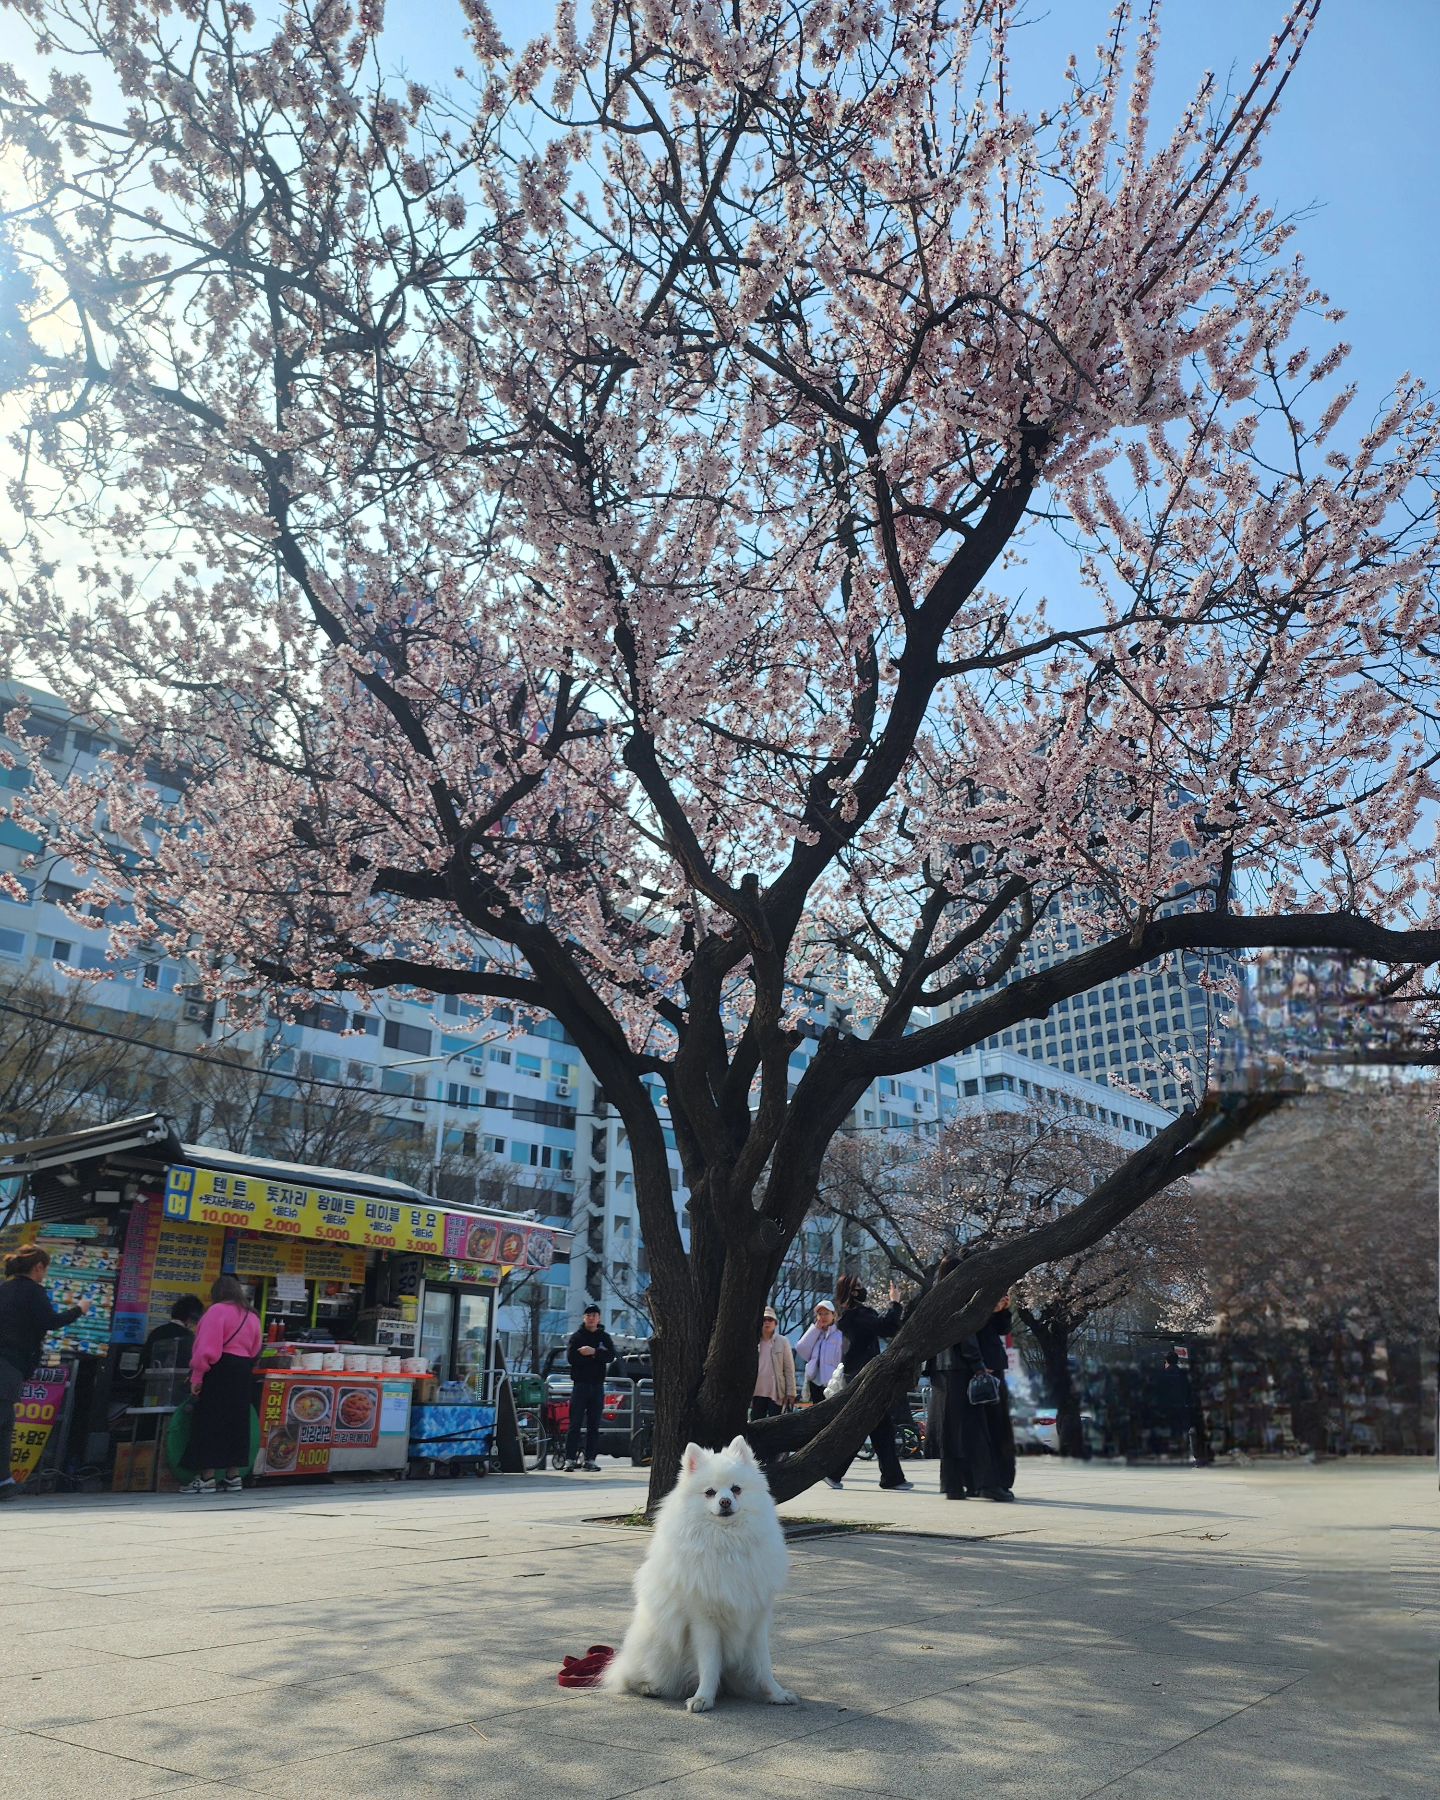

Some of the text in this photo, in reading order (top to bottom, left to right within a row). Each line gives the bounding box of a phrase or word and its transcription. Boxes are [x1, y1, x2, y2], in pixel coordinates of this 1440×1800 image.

[168, 1169, 192, 1215] 대여
[267, 1185, 307, 1207] 돗자리
[318, 1194, 355, 1215] 왕매트
[365, 1203, 400, 1222] 테이블
